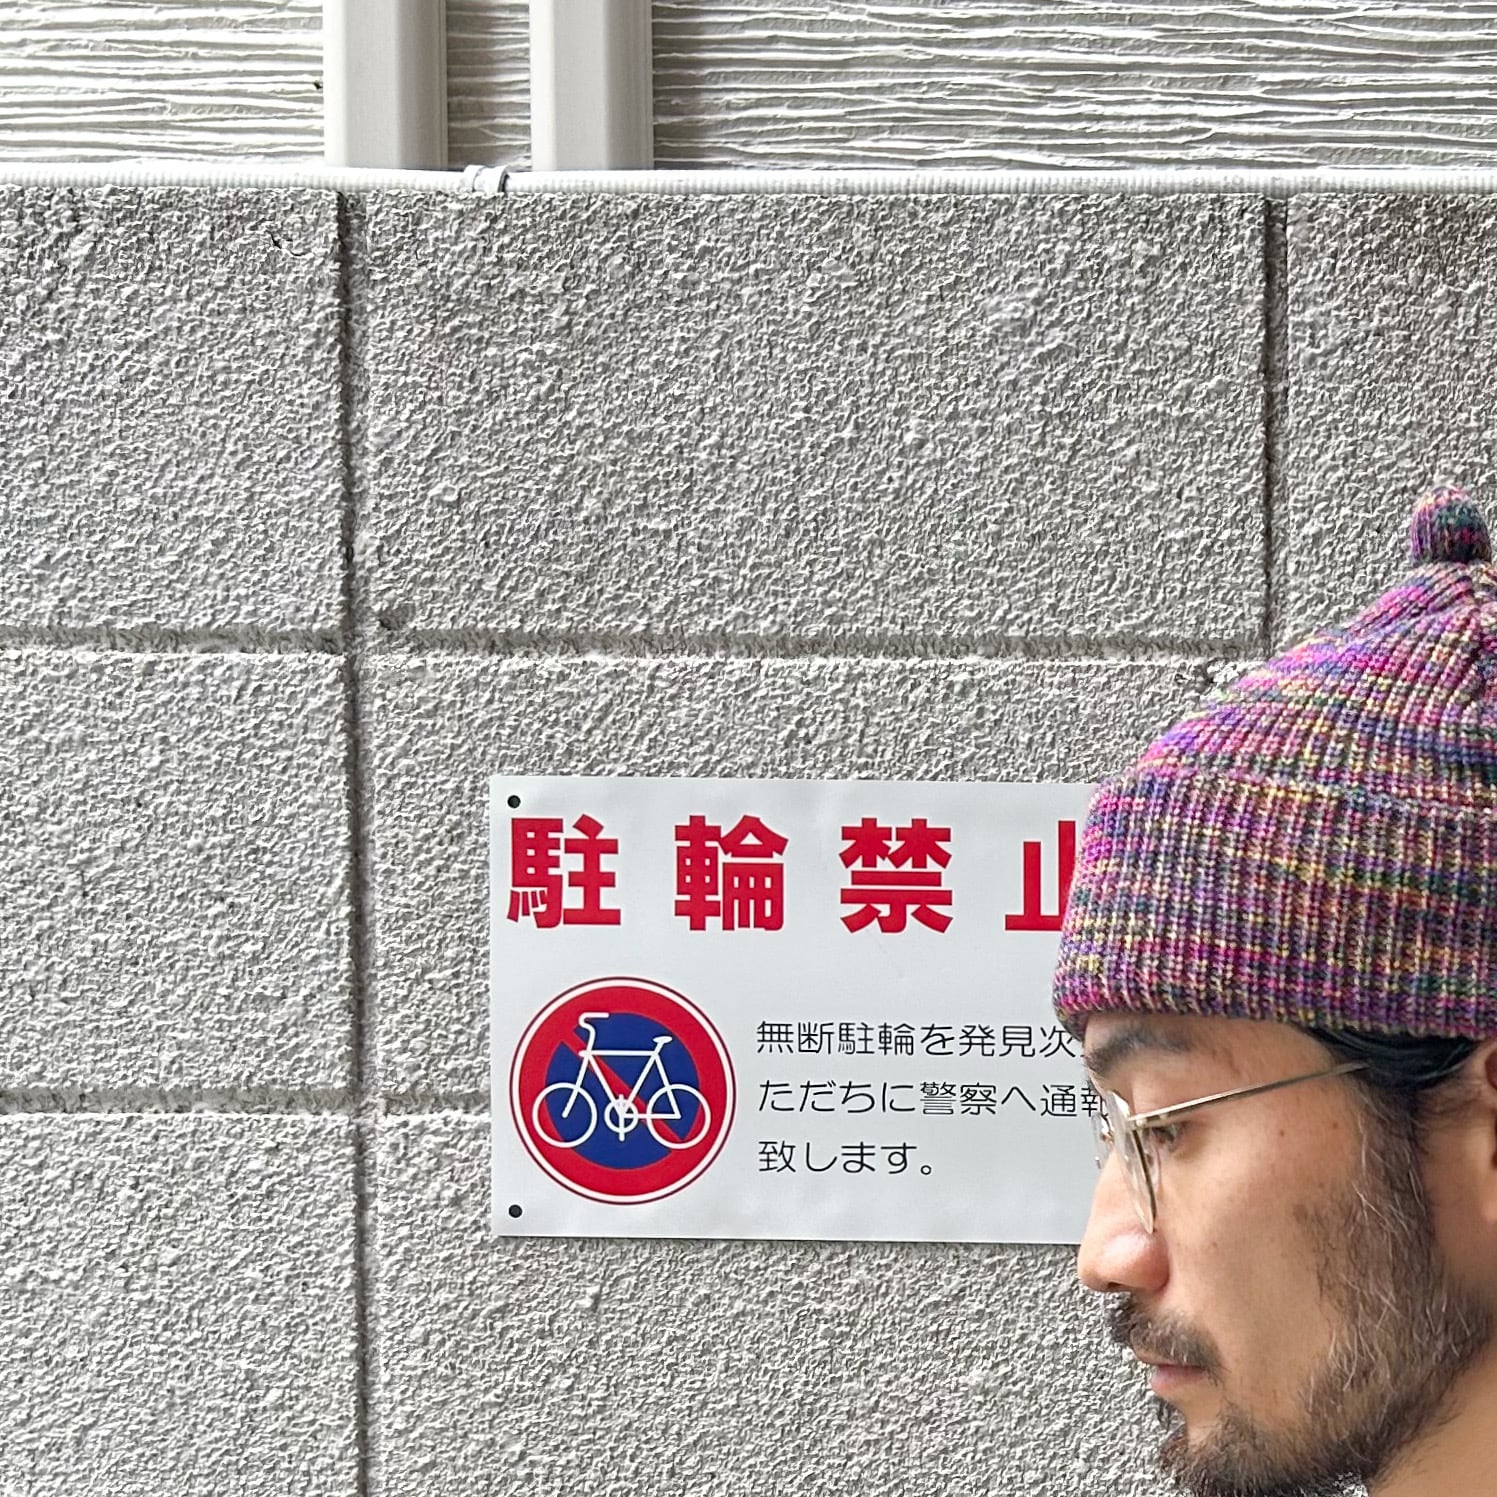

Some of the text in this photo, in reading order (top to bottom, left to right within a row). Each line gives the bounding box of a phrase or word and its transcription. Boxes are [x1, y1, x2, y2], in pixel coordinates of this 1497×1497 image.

[756, 1021, 1086, 1058] 無断駐輪を発見次
[757, 1141, 933, 1176] 致します。
